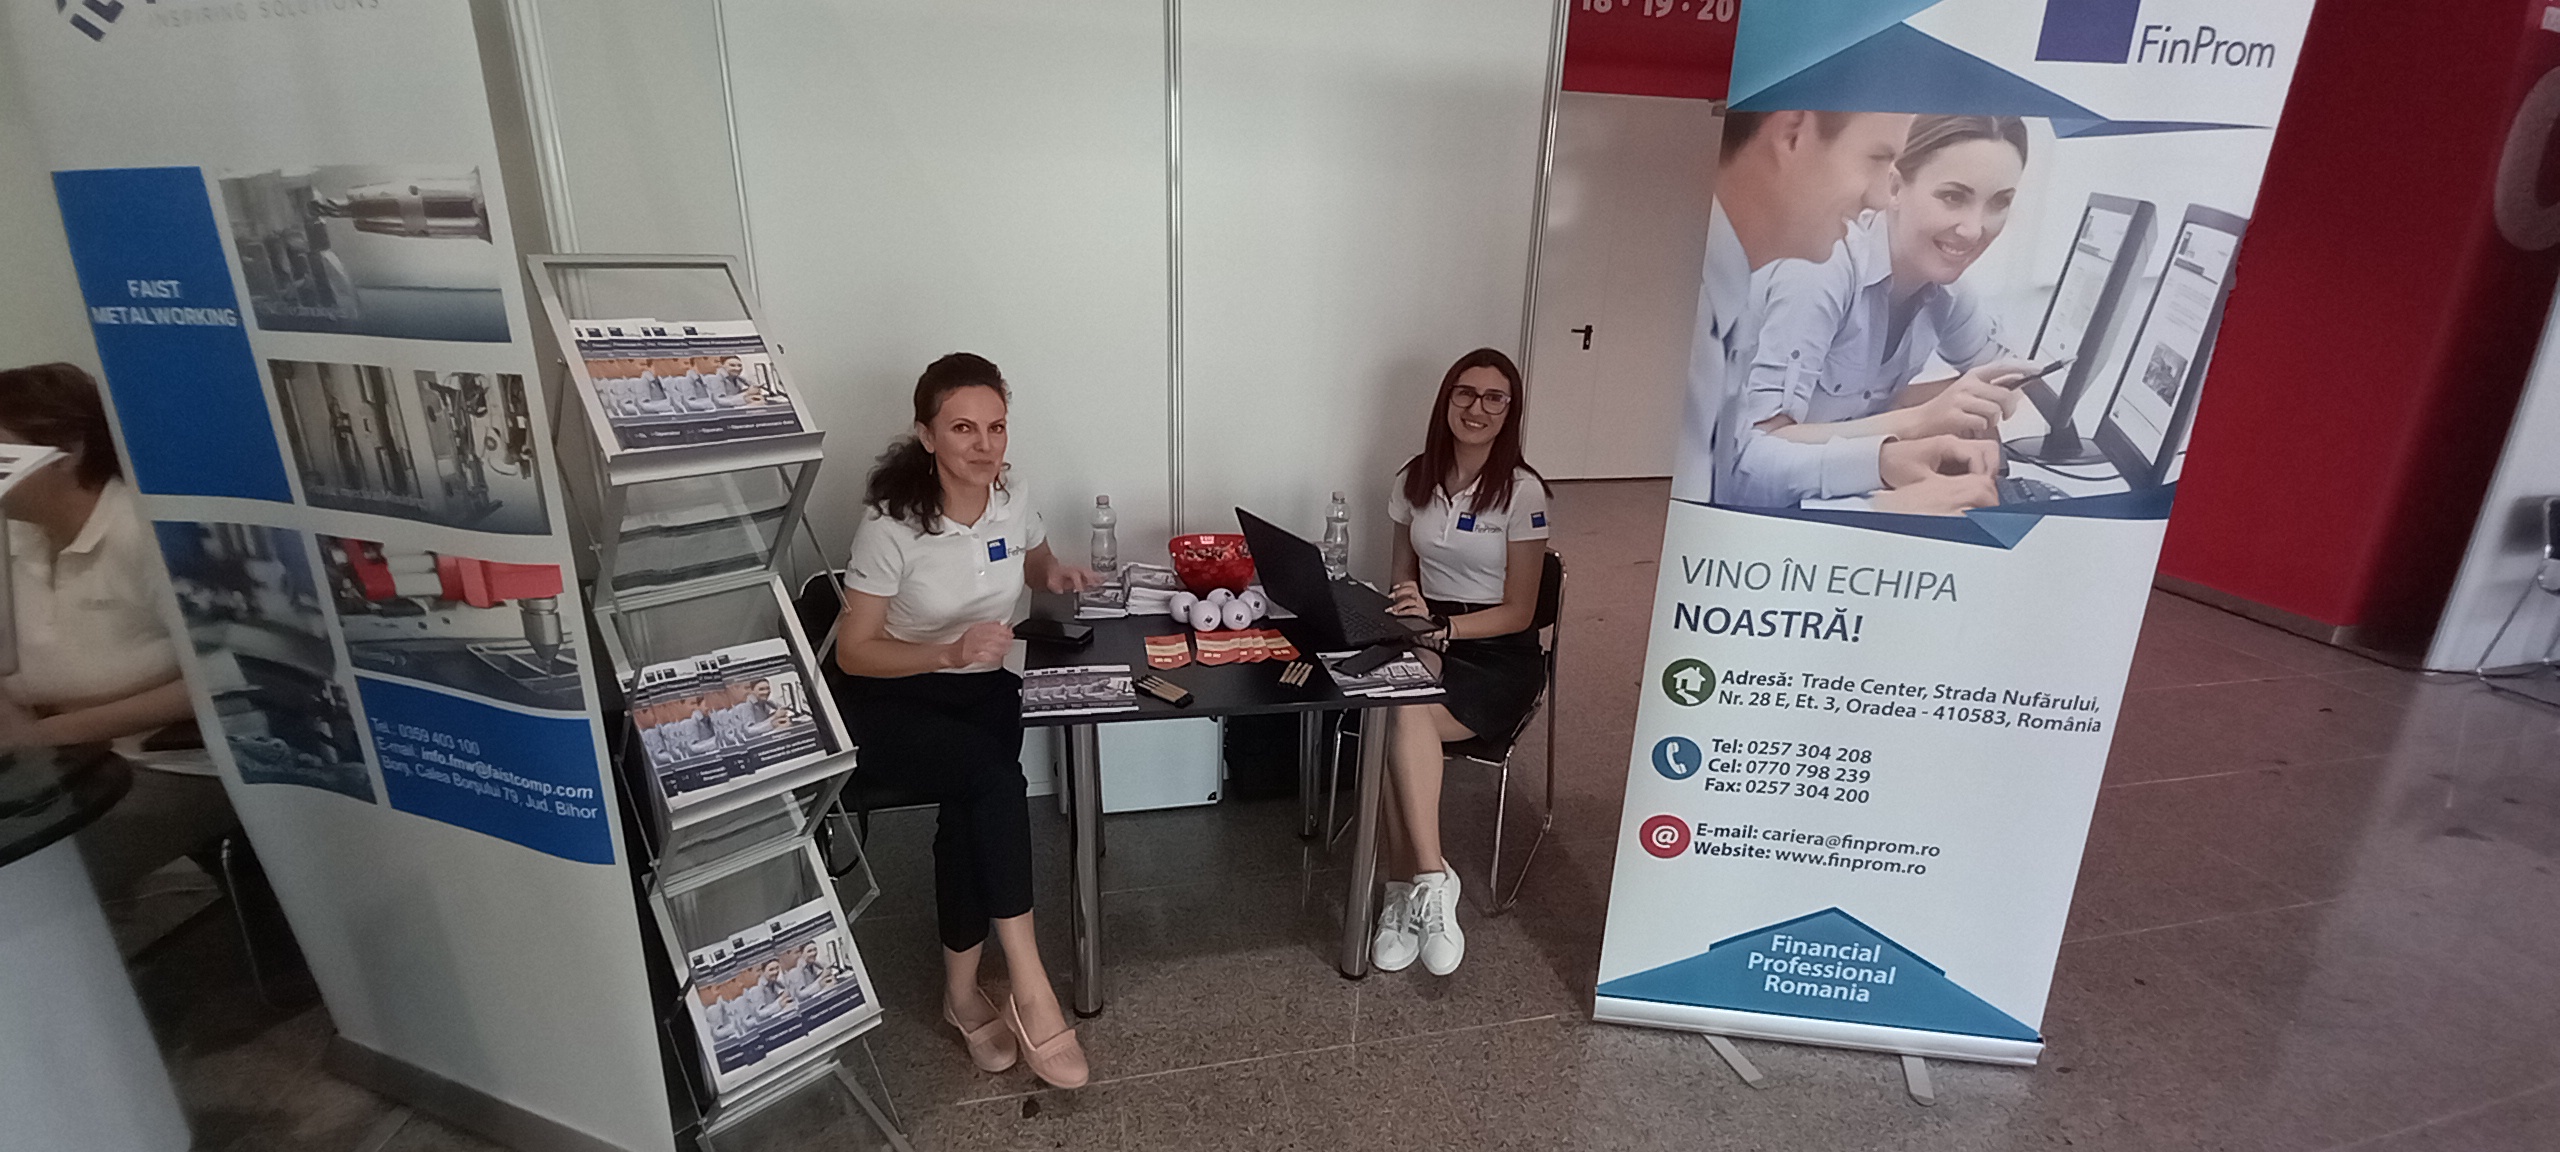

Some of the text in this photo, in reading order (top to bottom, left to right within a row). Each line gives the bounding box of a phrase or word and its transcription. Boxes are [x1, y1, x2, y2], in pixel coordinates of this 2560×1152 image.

[1697, 0, 1734, 23] 20
[2136, 24, 2276, 68] FinProm
[127, 279, 181, 299] FAIST
[91, 306, 237, 328] METALWORKING
[1681, 555, 1958, 602] VINO ÎN ECHIPA
[1673, 602, 1864, 643] NOASTRĂ!
[1721, 670, 2100, 713] Adresă: Trade Center, Strada Nufărului,
[1718, 690, 1744, 706] Nr.
[1748, 692, 1771, 707] 28
[1775, 693, 1791, 709] E,
[1795, 693, 1819, 709] Et.
[1823, 697, 1841, 713] 3,
[1846, 698, 1917, 718] Oradea
[1933, 705, 2012, 728] 410583,
[2016, 712, 2102, 733] România
[398, 723, 430, 743] 0359
[1712, 738, 1873, 764] Tel: 0257 304 208
[1708, 758, 1871, 784] Cel: 0770 798 239
[1704, 777, 1870, 804] Fax: 0257 304 200
[554, 800, 599, 820] Bihor
[1696, 823, 1941, 858] E-mail: cariera@finprom.ro
[1694, 841, 1927, 875] Website: www.finprom.ro
[1771, 934, 1882, 963] Financial
[1748, 951, 1897, 985] Professional
[1764, 974, 1870, 1003] Romania
